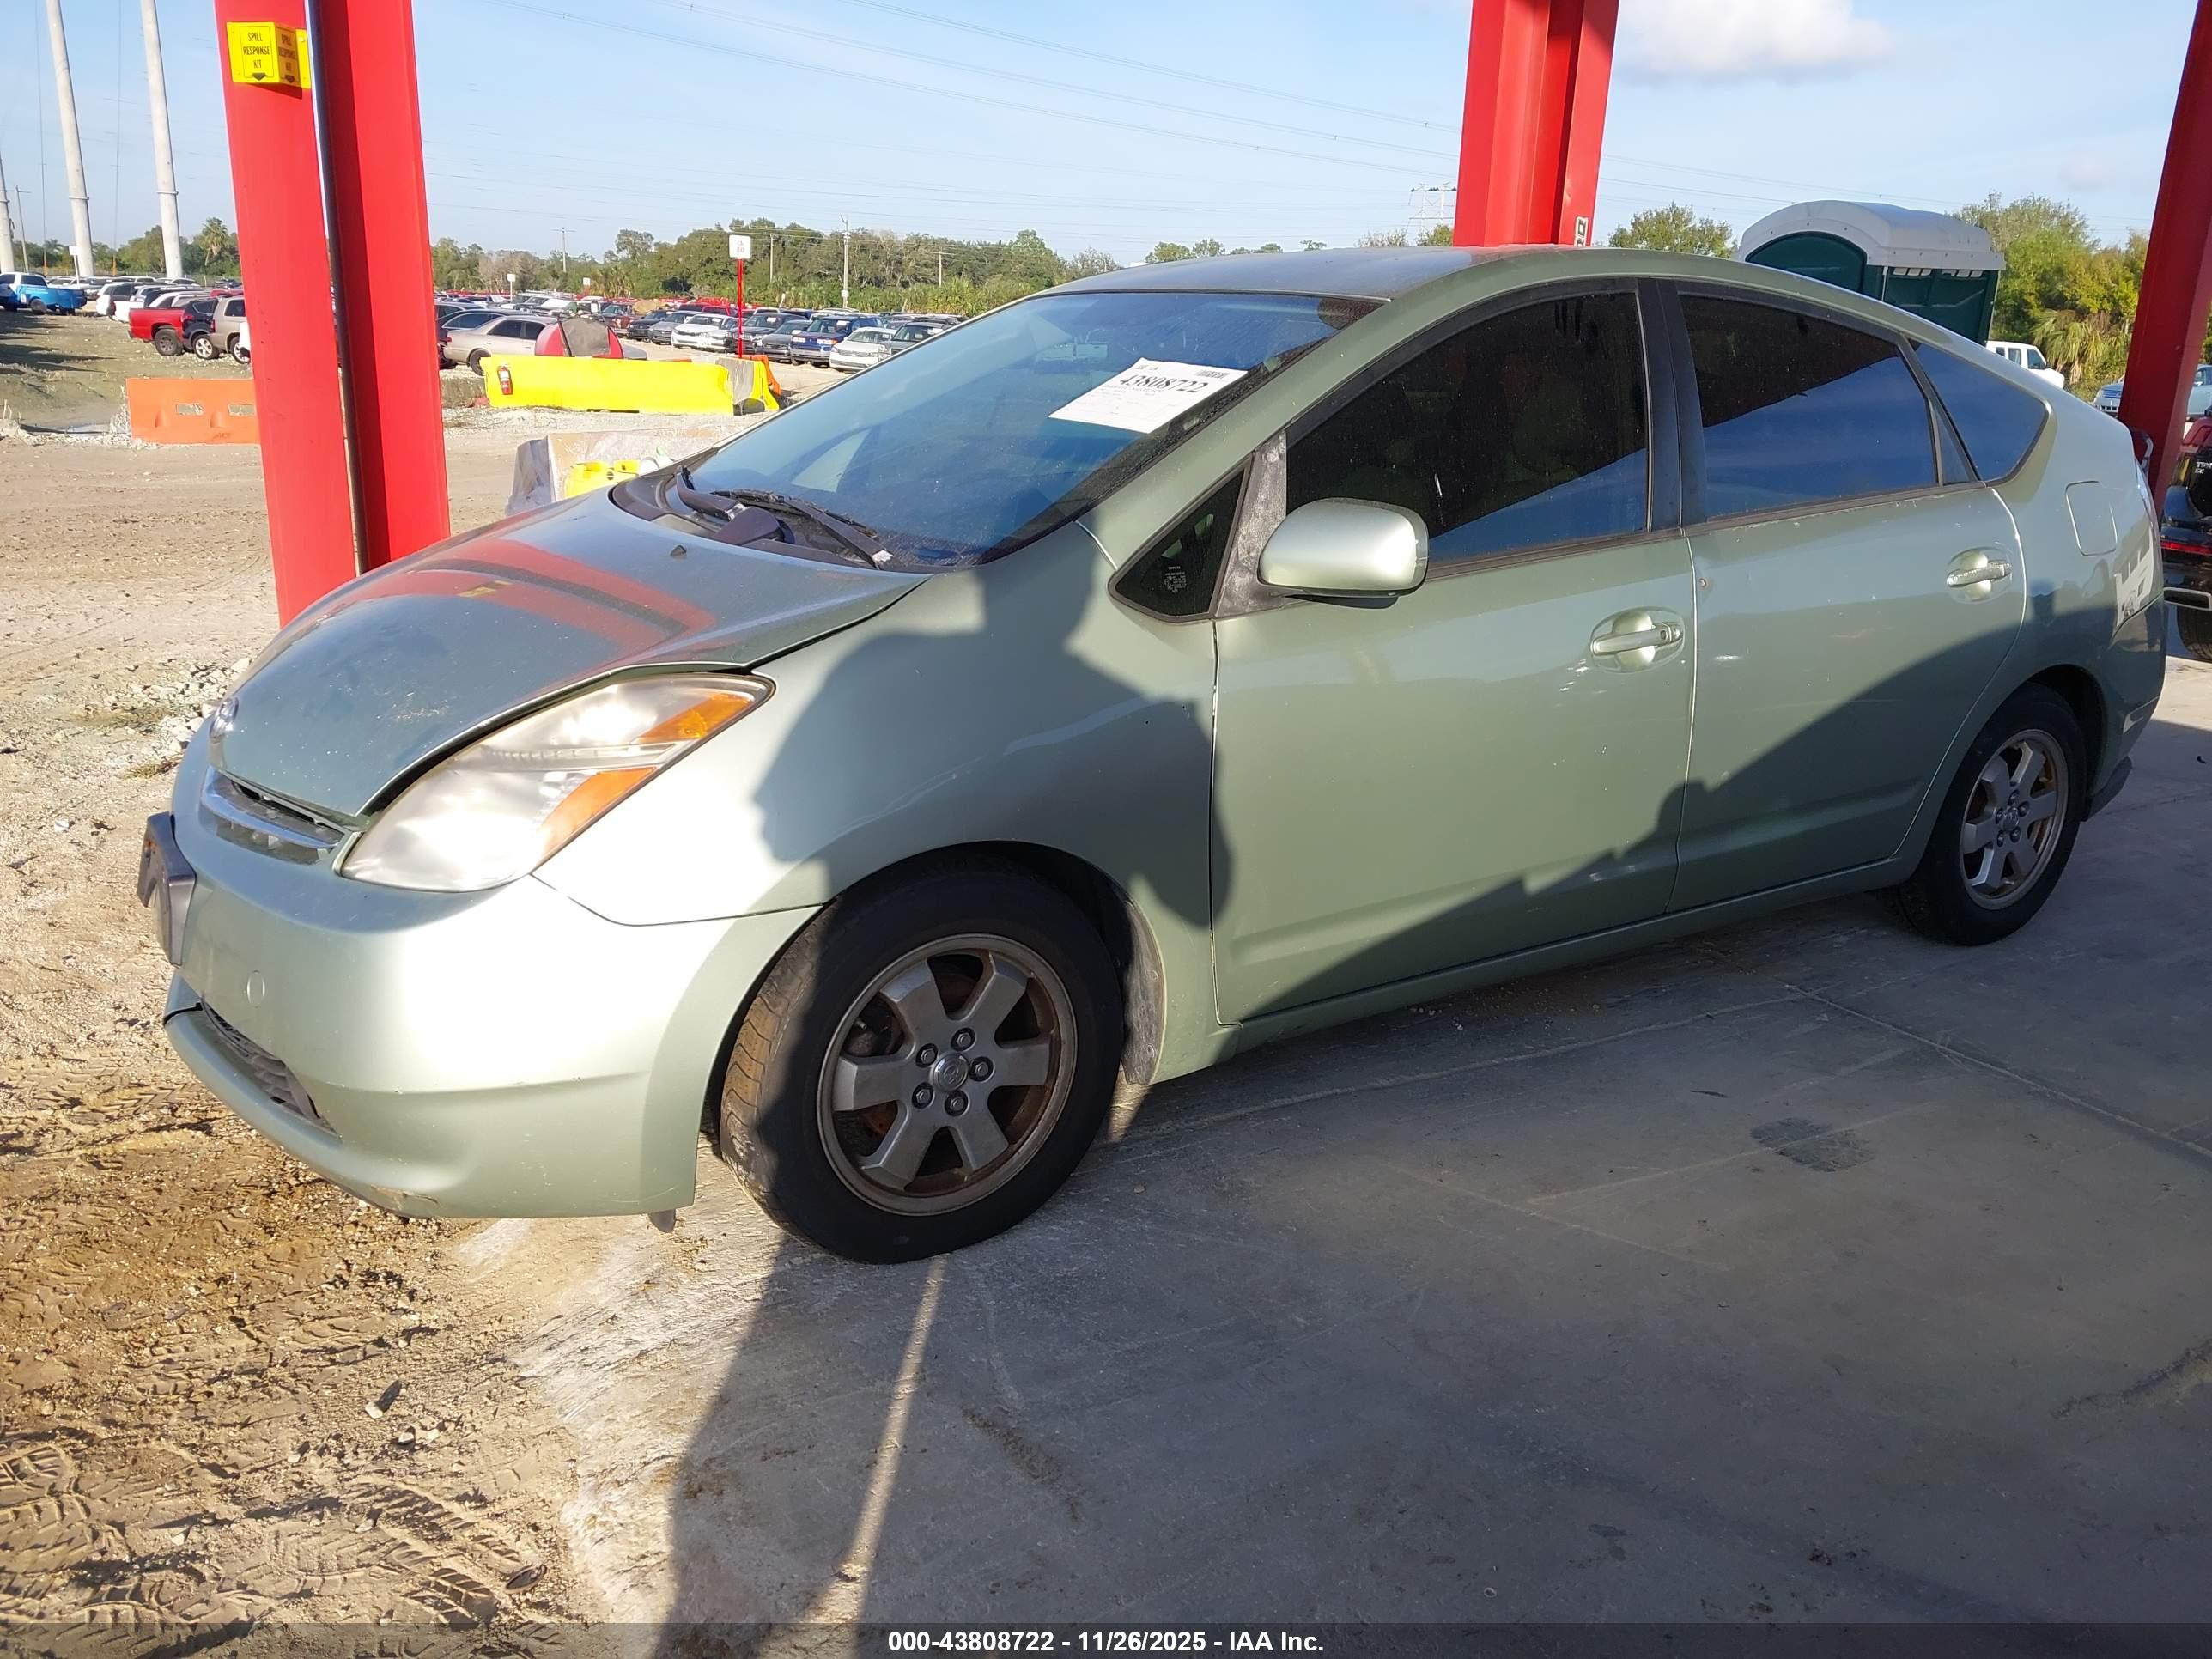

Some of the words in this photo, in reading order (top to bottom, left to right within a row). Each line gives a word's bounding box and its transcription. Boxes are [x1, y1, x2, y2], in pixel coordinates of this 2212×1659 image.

[247, 32, 263, 41] SPILL
[242, 46, 270, 55] RESPONSE
[253, 59, 262, 69] KIT
[1120, 374, 1209, 393] 43808722
